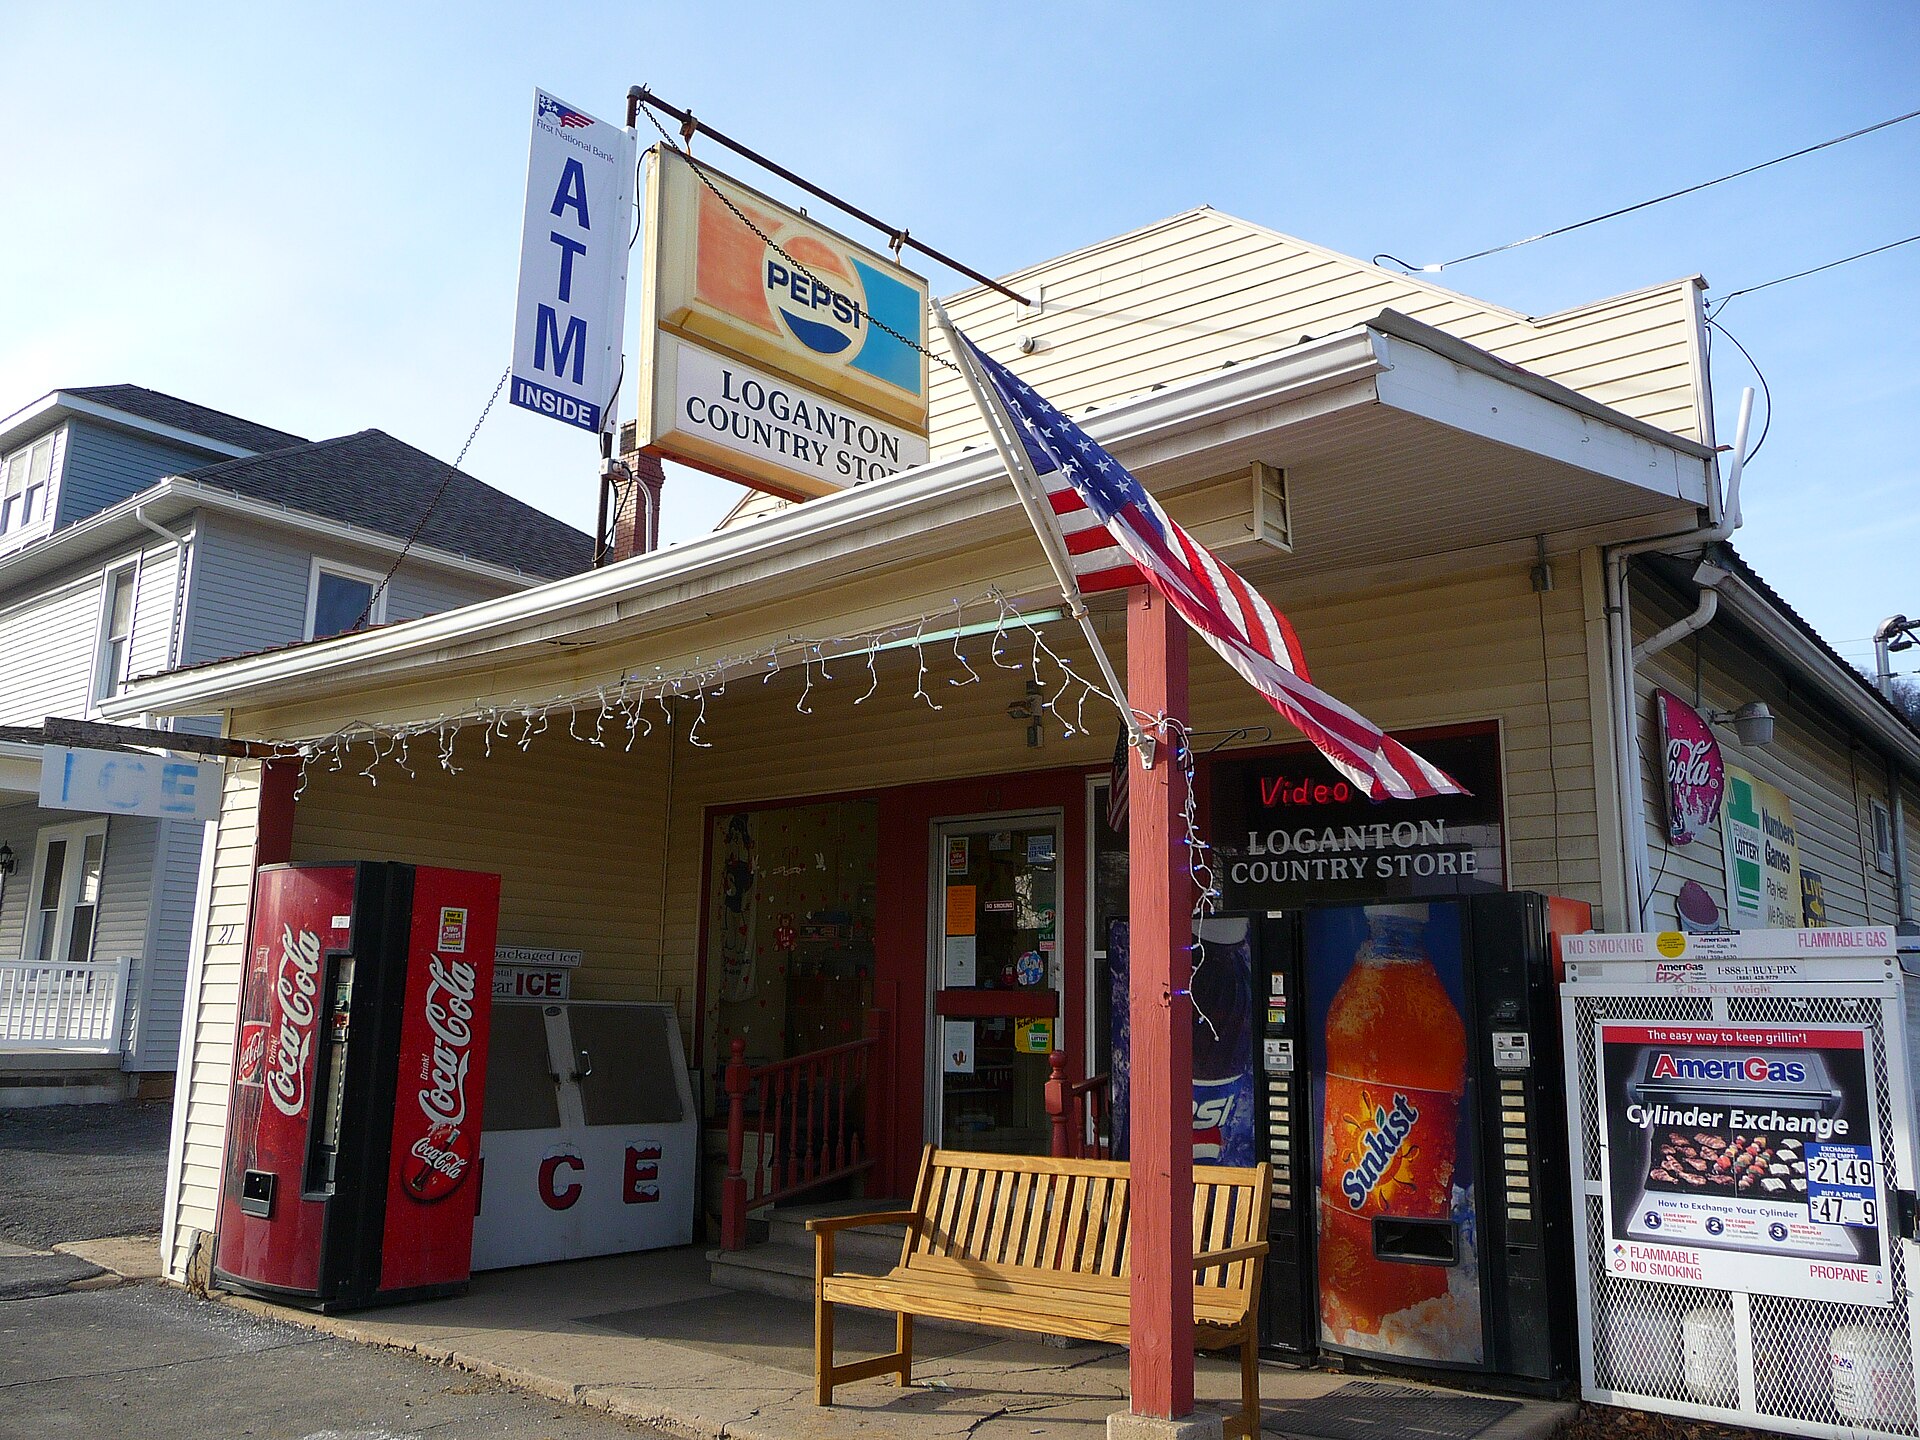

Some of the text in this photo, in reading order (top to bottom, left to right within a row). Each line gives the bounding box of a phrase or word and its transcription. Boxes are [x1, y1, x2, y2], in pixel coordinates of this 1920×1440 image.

[536, 118, 614, 163] First National Bank
[533, 157, 591, 386] ATM
[767, 259, 860, 330] PEPSI
[518, 382, 592, 427] INSIDE
[721, 369, 900, 463] LOGANTON
[686, 396, 829, 467] COUNTRY
[61, 752, 199, 813] ICE
[1260, 776, 1349, 806] Video
[1248, 819, 1446, 856] LOGANTON
[1761, 806, 1795, 847] Numbers
[1734, 836, 1760, 862] LOTTERY
[1764, 839, 1791, 875] Games
[1230, 851, 1479, 884] COUNTRY STORE
[1766, 877, 1776, 901] Play
[1803, 876, 1825, 899] LIVE
[1568, 940, 1584, 955] NO
[1588, 938, 1644, 954] SMOKING
[1799, 931, 1888, 948] FLAMMABLE GAS
[560, 952, 578, 962] ice
[1657, 962, 1704, 971] AmeriGas
[515, 972, 563, 996] ICE
[1733, 983, 1773, 996] Weight
[267, 922, 320, 1116] Coca-Cola
[268, 1034, 279, 1066] Drink!
[418, 952, 476, 1126] Coca-Cola
[1647, 1029, 1807, 1045] The easy way to keep grillin'!
[420, 1053, 430, 1081] Drink!
[1652, 1053, 1806, 1083] AmeriGas
[1626, 1104, 1849, 1139] Cylinder Exchange
[411, 1137, 468, 1179] Coca-Cola
[1341, 1091, 1420, 1211] Sunkist
[1820, 1145, 1856, 1154] EXCHANGE
[1837, 1152, 1858, 1160] EMPTY
[1808, 1158, 1872, 1186] $21.49
[1657, 1199, 1799, 1220] How to Exchange Your Cylinder
[1842, 1191, 1861, 1199] SPARE
[1630, 1246, 1700, 1266] FLAMMABLE
[1630, 1261, 1703, 1281] NO SMOKING
[1809, 1264, 1869, 1284] PROPANE
